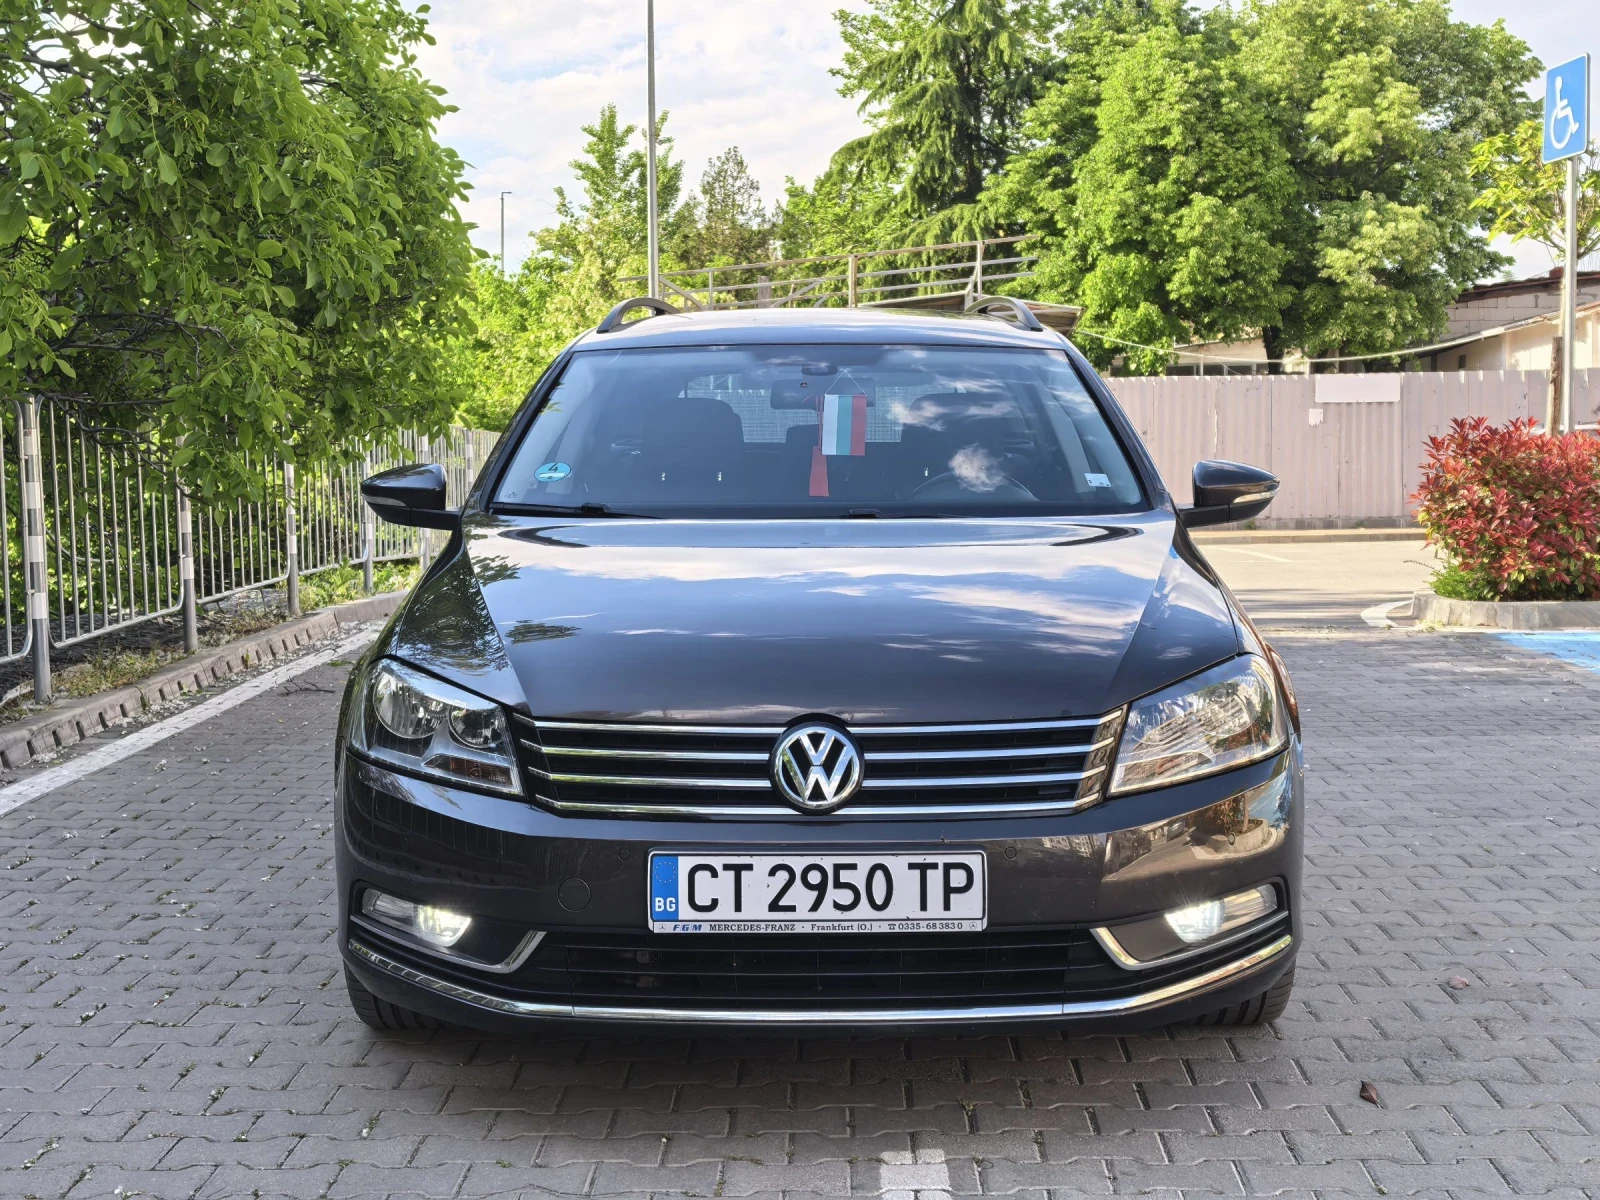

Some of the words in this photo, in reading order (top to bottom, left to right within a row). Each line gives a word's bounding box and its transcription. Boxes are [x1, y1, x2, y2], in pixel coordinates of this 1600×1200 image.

[687, 863, 753, 912] CT
[768, 863, 893, 912] 2950
[908, 862, 974, 911] TP
[655, 897, 676, 912] BG
[811, 923, 854, 931] Frankfurt
[857, 923, 873, 931] (O.)
